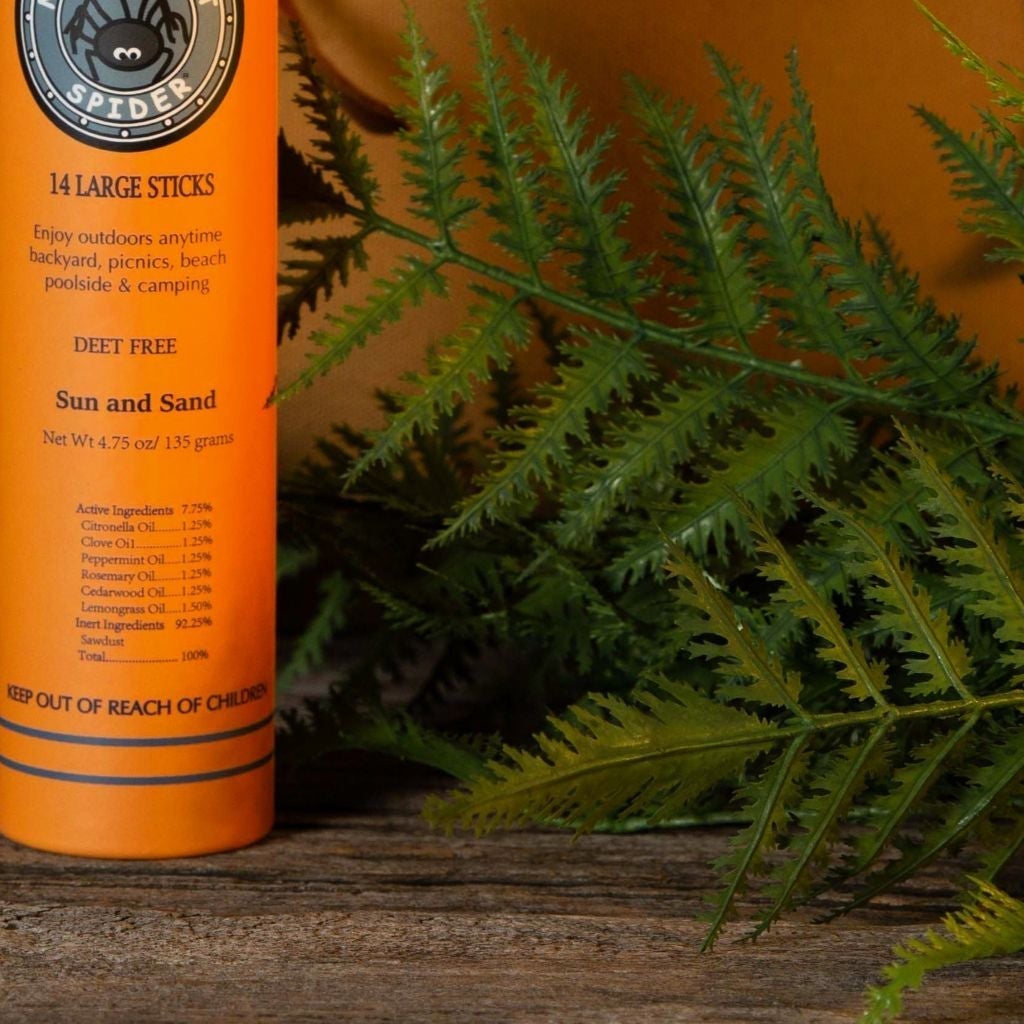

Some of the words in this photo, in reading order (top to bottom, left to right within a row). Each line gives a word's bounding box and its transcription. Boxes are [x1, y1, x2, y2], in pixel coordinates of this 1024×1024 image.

[66, 77, 192, 120] SPIDER
[50, 173, 70, 195] 14
[76, 174, 142, 198] LARGE
[148, 173, 214, 198] STICKS
[34, 224, 73, 247] Enjoy
[78, 229, 152, 245] outdoors
[158, 228, 223, 248] anytime
[30, 245, 102, 270] backyard,
[109, 254, 173, 273] picnics,
[180, 249, 226, 269] beach
[45, 272, 112, 292] poolside
[119, 278, 131, 292] &
[138, 277, 210, 296] camping
[74, 337, 124, 354] DEET
[130, 338, 176, 354] FREE
[56, 390, 99, 411] Sun
[107, 393, 152, 412] and
[160, 390, 216, 412] Sand
[43, 430, 67, 446] Net
[71, 433, 94, 448] Wt
[98, 436, 130, 449] 4.75
[134, 436, 159, 450] oz/
[166, 435, 191, 449] 135
[194, 434, 234, 452] grams
[76, 504, 110, 515] Active
[112, 505, 174, 519] Ingredients
[182, 503, 213, 513] 7.75%
[81, 518, 135, 532] Citronella
[136, 520, 156, 533] Oil
[81, 536, 113, 548] Clove
[115, 538, 134, 549] Oil
[82, 553, 145, 567] Peppermint
[146, 553, 166, 566] Oil
[81, 569, 135, 584] Rosemary
[136, 570, 156, 582] Oil
[81, 585, 144, 598] Cedarwood
[146, 586, 166, 598] Oil
[81, 601, 145, 617] Lemongrass
[147, 602, 166, 615] Oil
[76, 617, 100, 629] Inert
[104, 620, 165, 633] Ingredients
[81, 635, 124, 646] Sawdust
[182, 650, 209, 661] 100%
[7, 683, 33, 704] KEEP
[36, 692, 72, 711] OUT
[77, 698, 102, 714] OF
[109, 700, 171, 716] REACH
[177, 697, 202, 714] OF
